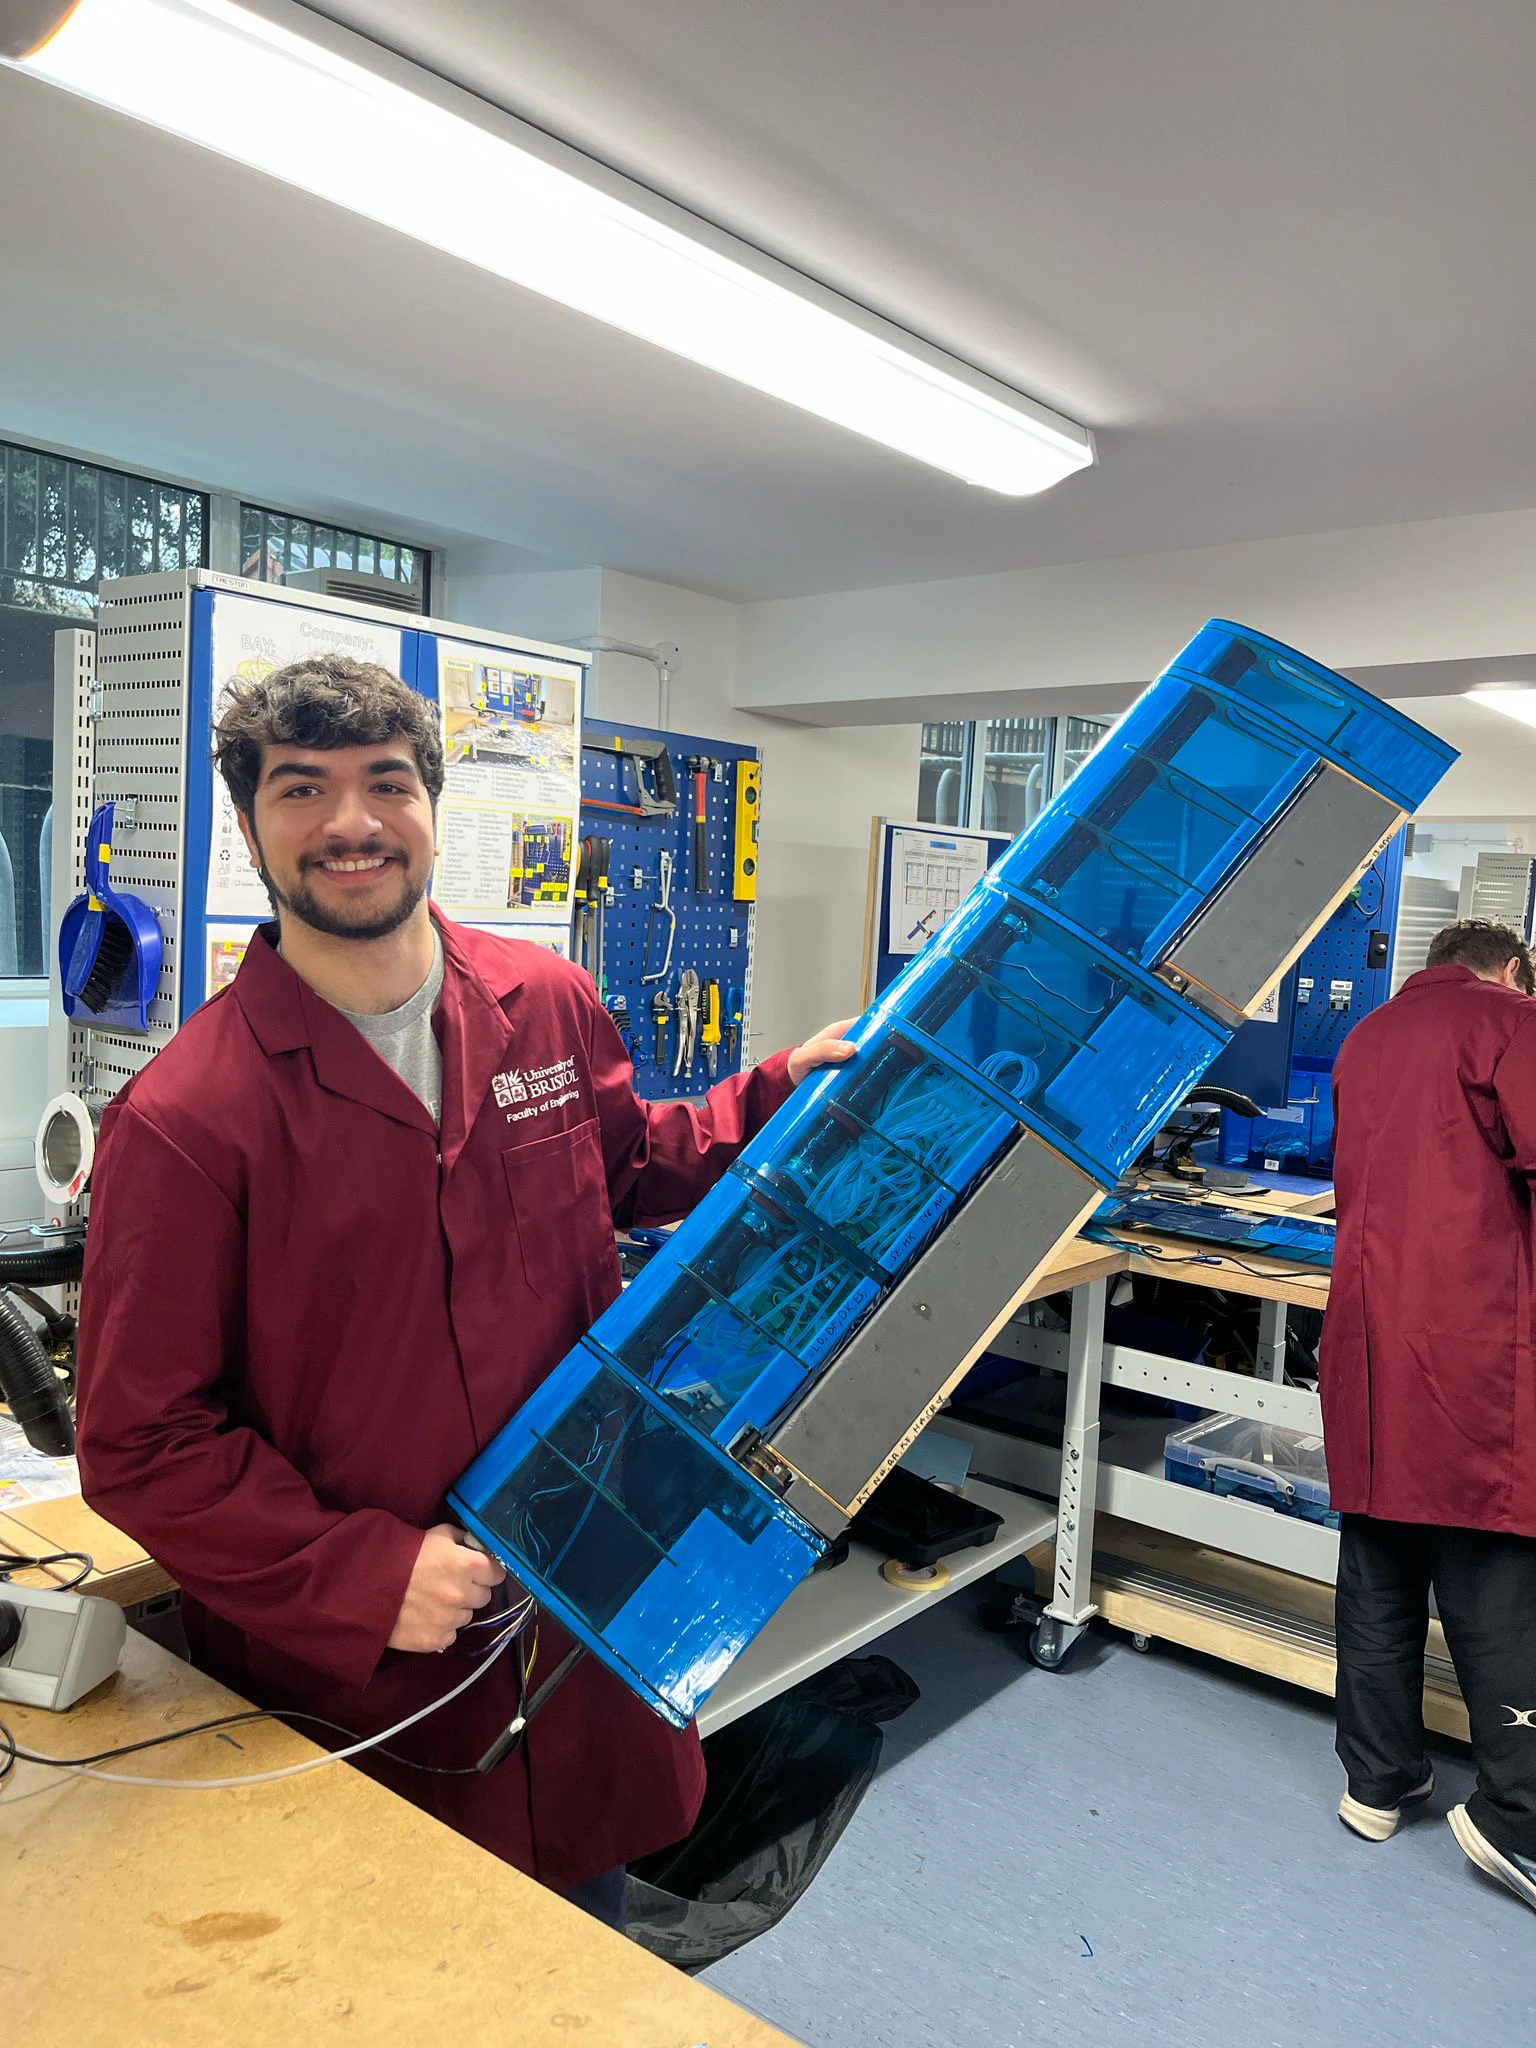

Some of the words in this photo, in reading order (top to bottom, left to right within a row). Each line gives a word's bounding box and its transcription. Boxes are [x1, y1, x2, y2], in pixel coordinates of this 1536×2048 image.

[240, 633, 277, 655] BAY:
[300, 621, 374, 650] Company:
[566, 1054, 576, 1068] of
[527, 1068, 580, 1099] BRISTOL
[506, 1106, 538, 1124] Faculty
[539, 1100, 550, 1112] of
